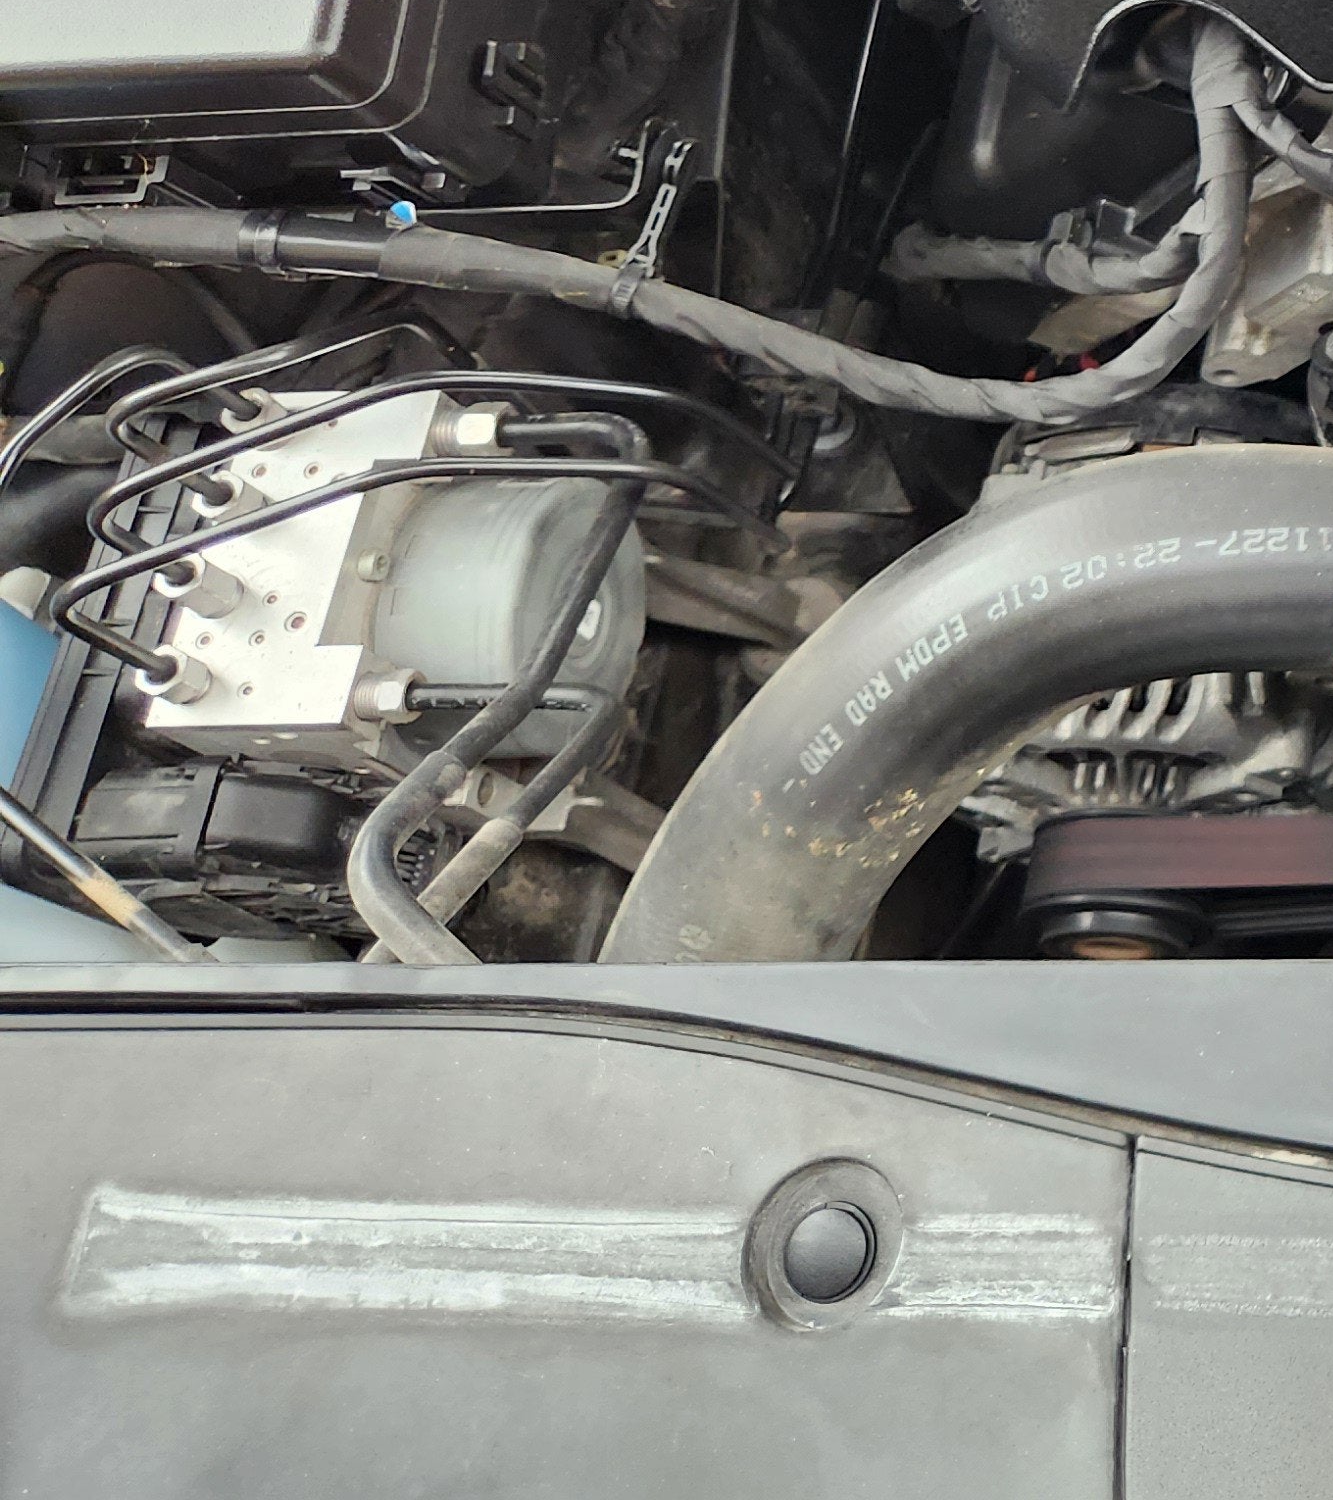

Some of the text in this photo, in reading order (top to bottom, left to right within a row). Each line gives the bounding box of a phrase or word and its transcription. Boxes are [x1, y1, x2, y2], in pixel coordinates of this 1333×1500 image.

[986, 574, 1050, 622] CIP
[894, 613, 969, 682] EPDM
[845, 671, 893, 727] RAD
[800, 723, 844, 776] END
